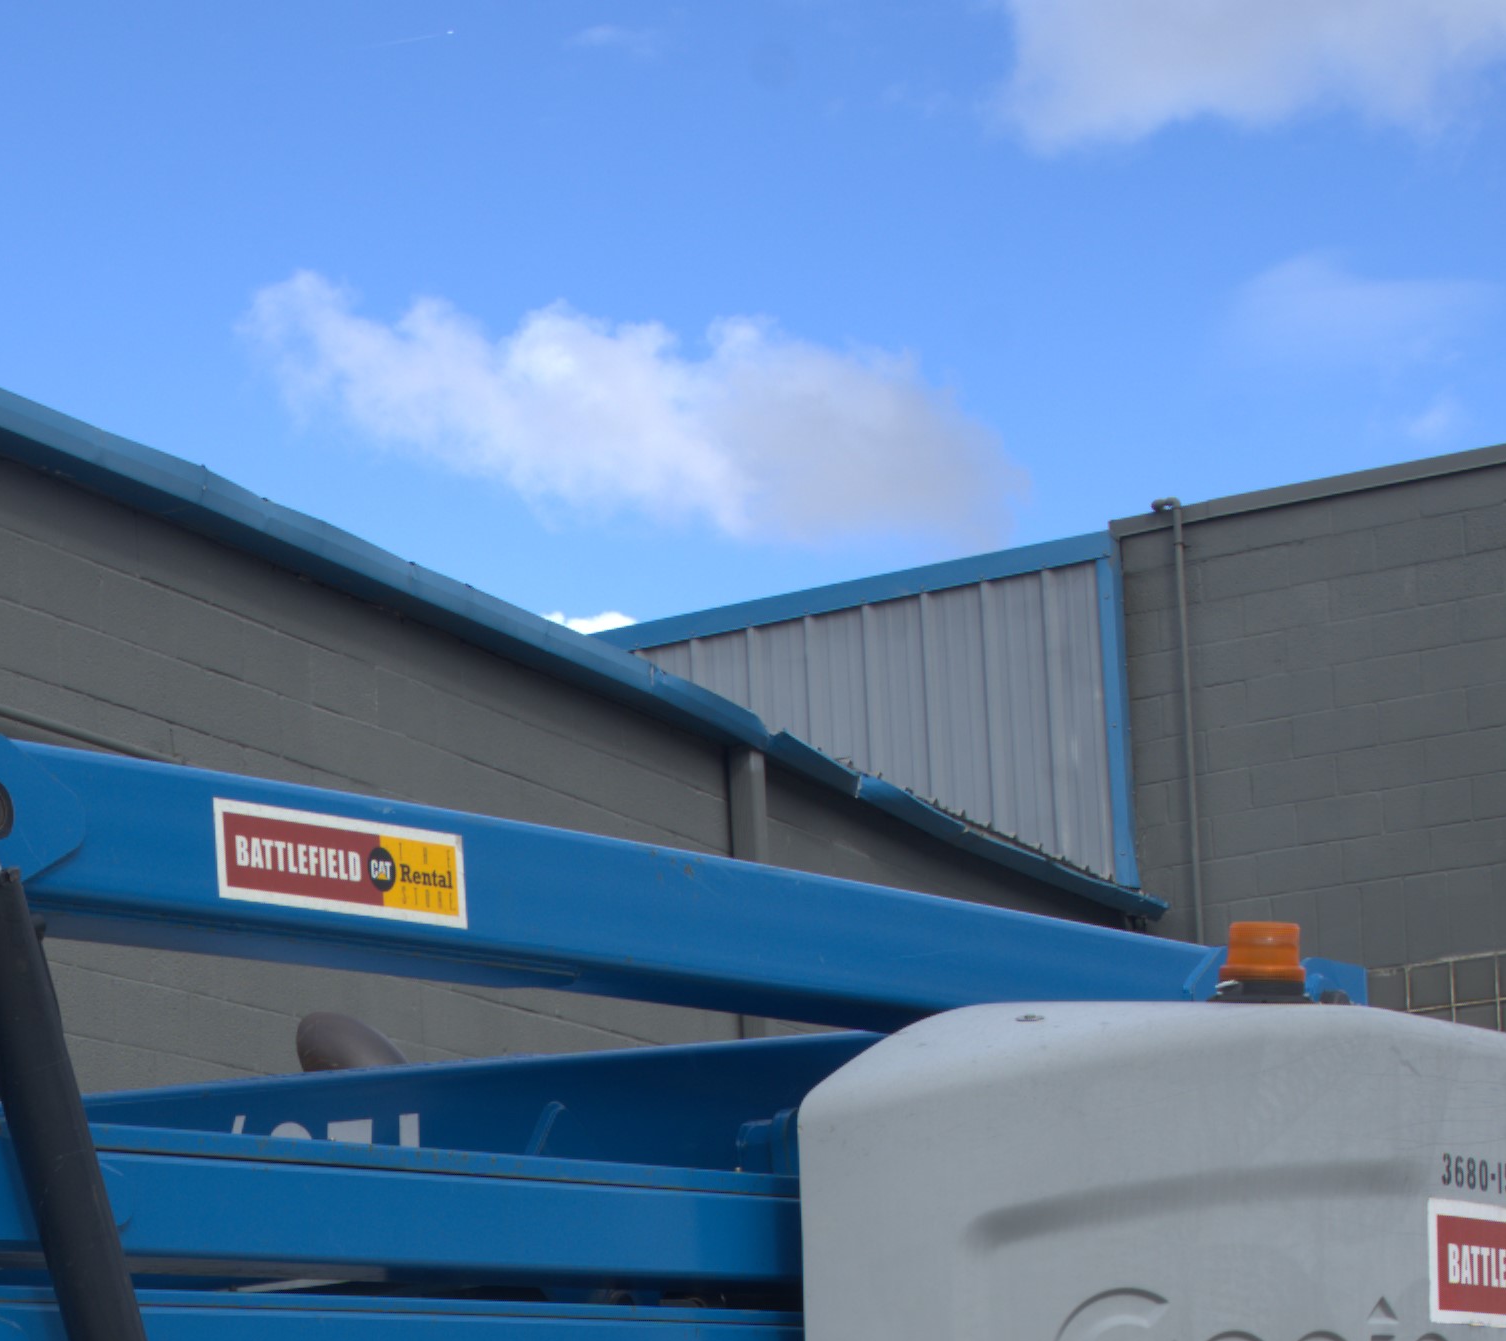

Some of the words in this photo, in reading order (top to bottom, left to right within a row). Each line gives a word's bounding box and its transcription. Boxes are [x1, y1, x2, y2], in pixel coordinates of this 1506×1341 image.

[235, 834, 362, 883] BATTLEFIELD
[369, 858, 393, 881] CAT
[399, 863, 454, 890] Rental
